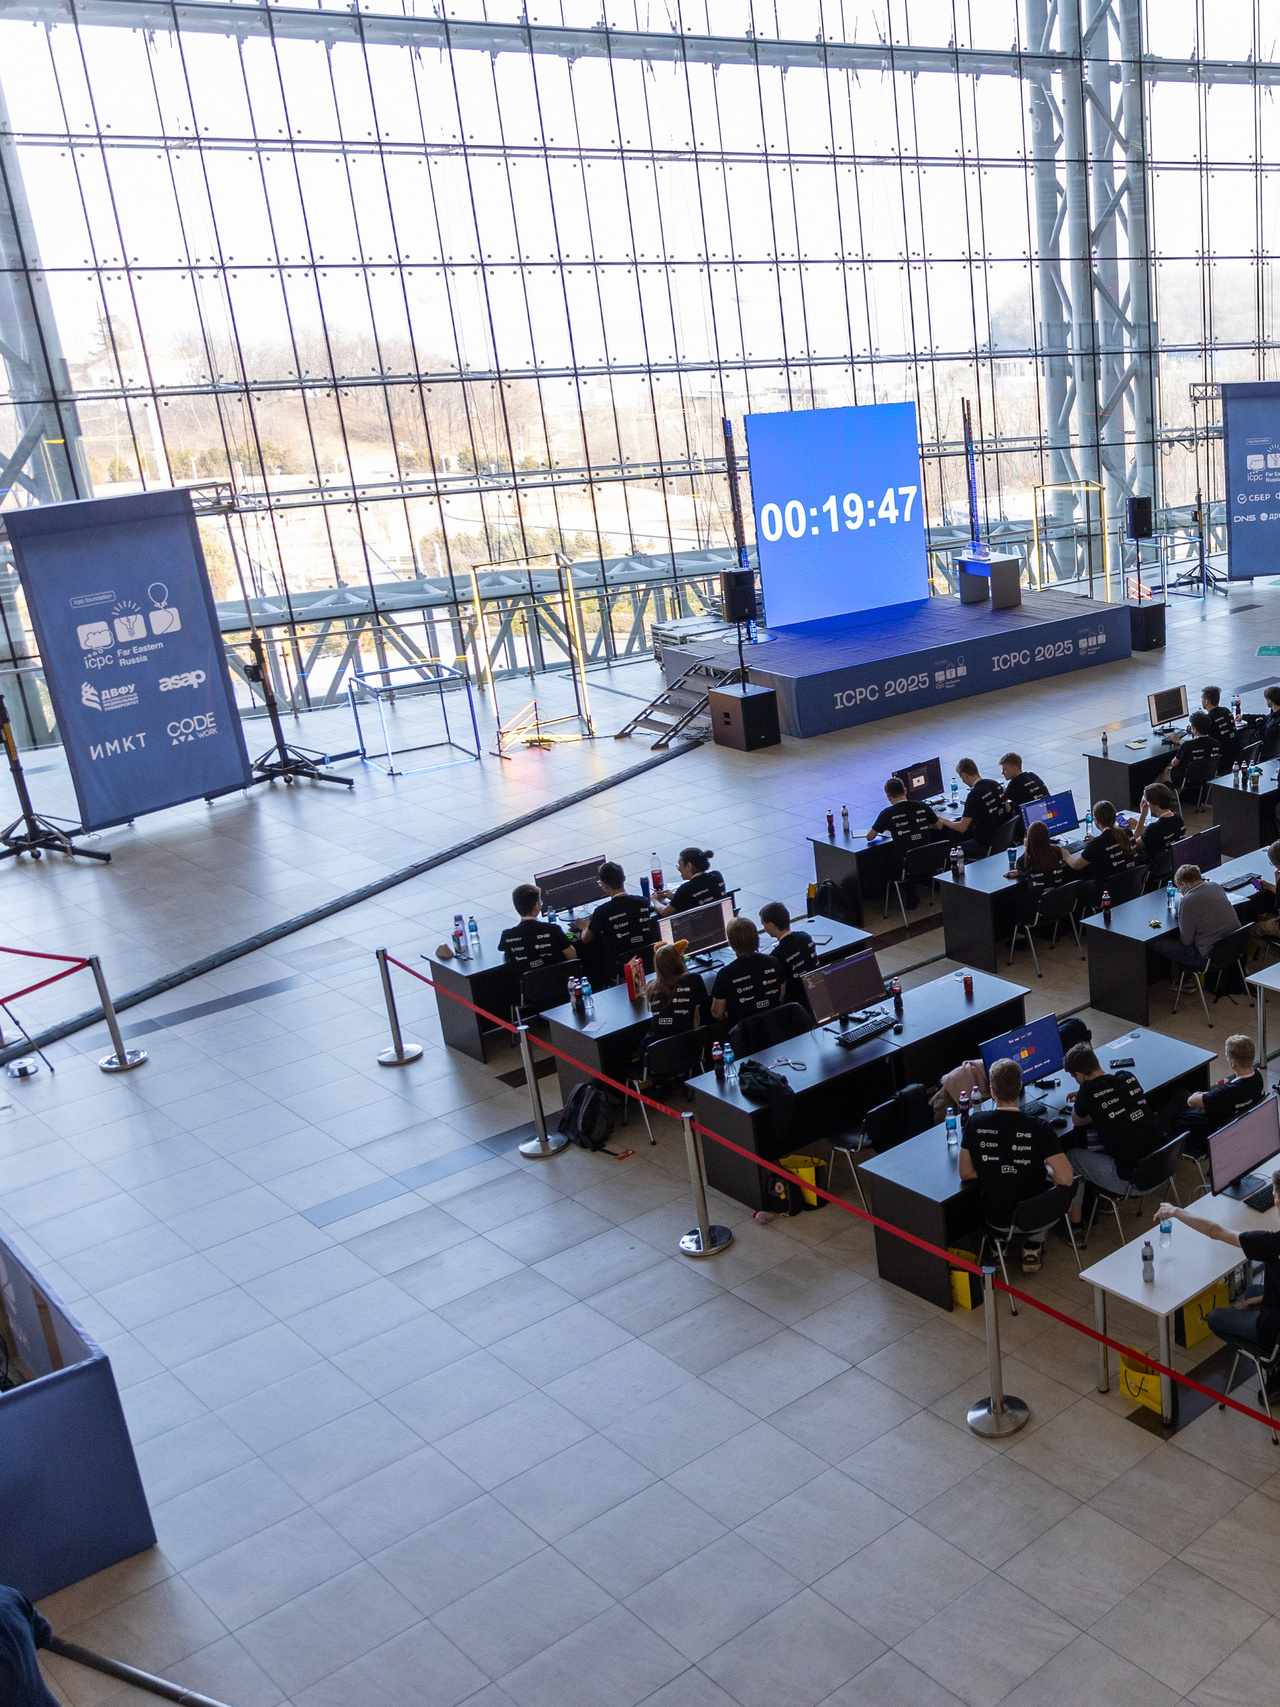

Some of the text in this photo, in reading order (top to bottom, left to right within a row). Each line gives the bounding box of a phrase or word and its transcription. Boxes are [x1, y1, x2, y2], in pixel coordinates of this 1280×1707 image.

[1248, 493, 1271, 502] СБЕР
[760, 485, 918, 542] 00:19:47
[1233, 514, 1256, 523] DNS
[117, 641, 164, 657] Far Eastern
[992, 650, 1030, 672] ICPC
[1034, 639, 1074, 662] 2025
[84, 654, 114, 669] icpc
[119, 654, 148, 667] Russia
[158, 669, 206, 692] asap
[101, 683, 136, 700] ДВФУ
[834, 672, 930, 710] ICPC 2025
[167, 712, 217, 737] CODE
[197, 727, 218, 739] WORK
[90, 732, 147, 760] ИМКТ
